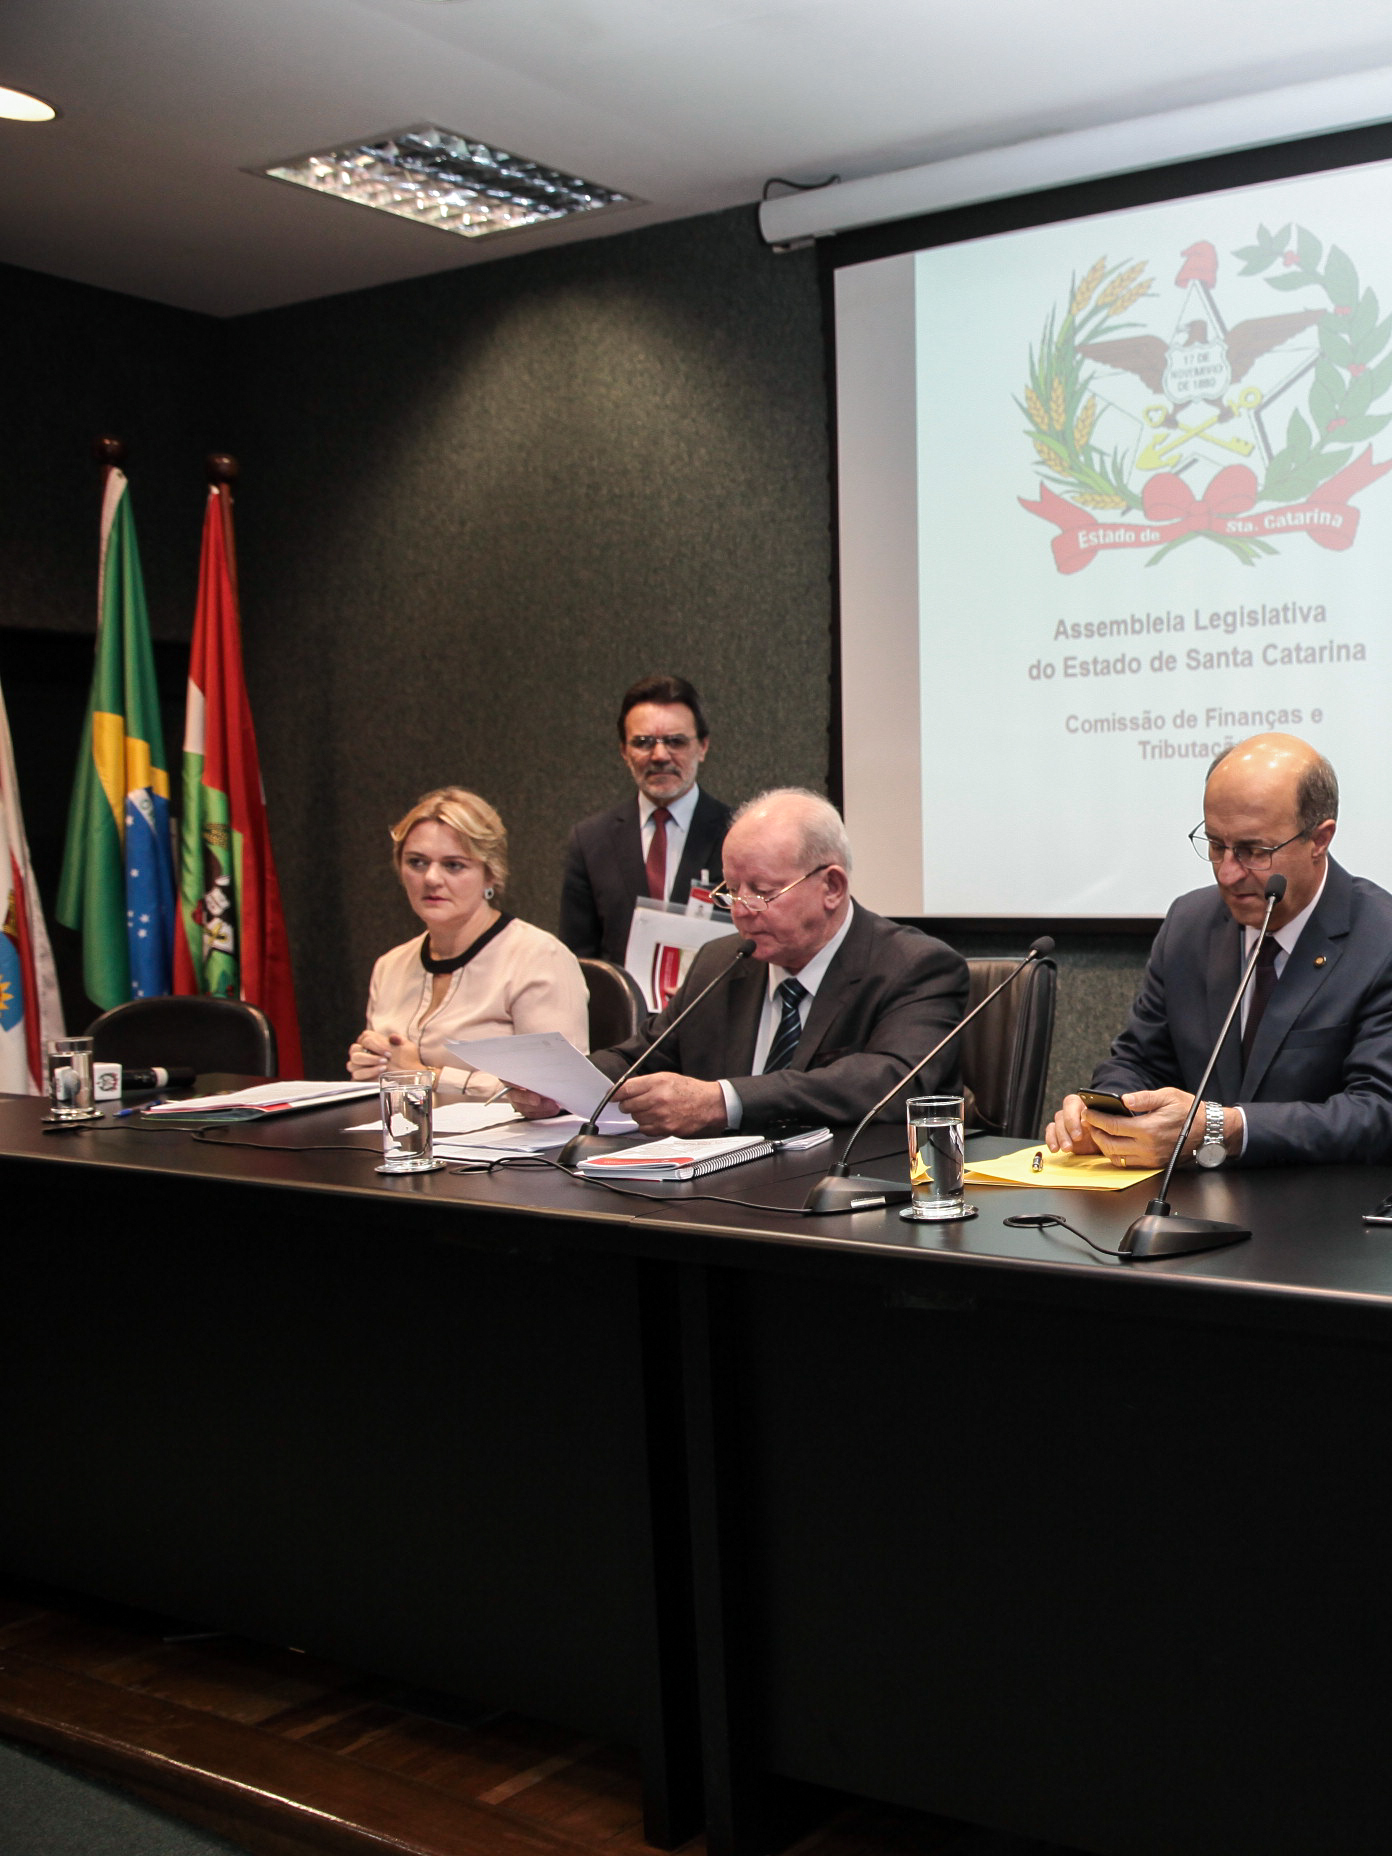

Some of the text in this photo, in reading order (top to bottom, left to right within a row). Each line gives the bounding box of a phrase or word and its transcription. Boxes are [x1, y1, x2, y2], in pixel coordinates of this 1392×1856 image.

[1078, 507, 1343, 549] Estado de Sta. Catarina
[1053, 601, 1327, 641] Assembleia Legislativa
[1028, 639, 1367, 681] do Estado de Santa Catarina
[1065, 705, 1324, 735] Comissão de Finanças e
[1138, 735, 1240, 760] Tributaç
